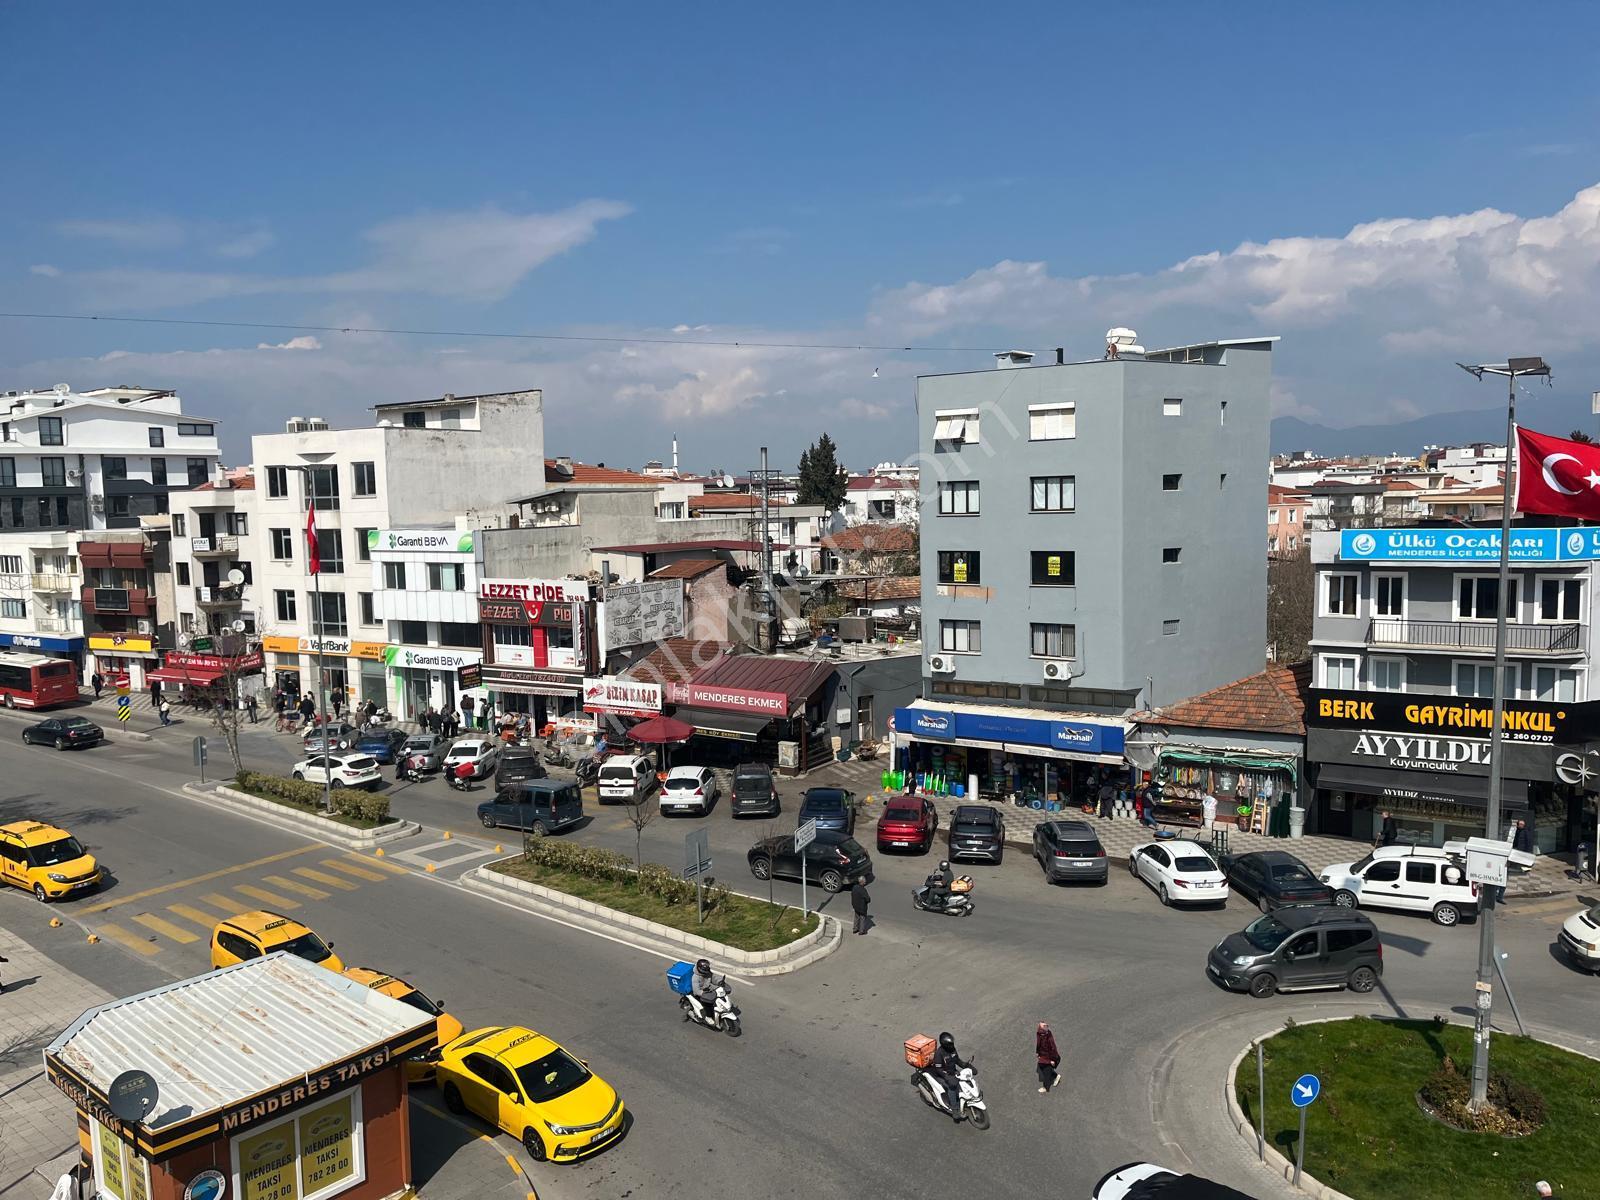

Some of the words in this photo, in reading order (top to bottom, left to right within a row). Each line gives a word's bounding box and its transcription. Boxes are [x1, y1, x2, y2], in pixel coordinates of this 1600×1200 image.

[397, 536, 423, 547] Garanti
[424, 536, 448, 546] BBVA
[1389, 532, 1436, 548] Ülkü
[1449, 549, 1473, 558] İLÇE
[1475, 549, 1543, 558] BAŞANLIĞI
[481, 584, 530, 600] LEZZET
[533, 582, 564, 601] PİDE
[480, 605, 521, 619] LEZZET
[553, 605, 572, 621] PİD
[310, 640, 349, 652] VakıfBank
[413, 655, 440, 664] Garanti
[440, 656, 464, 666] BBVA
[606, 684, 629, 701] BİZİM
[629, 687, 658, 703] KASAP
[694, 691, 746, 705] MENDERES
[748, 697, 783, 709] EKMEK
[1319, 699, 1375, 720] BERK
[917, 720, 948, 729] Marshall
[1058, 732, 1092, 742] Marshall
[1352, 734, 1492, 765] AYYILDIZ
[1390, 758, 1459, 771] Kuyumculuk
[1382, 788, 1419, 799] AYYILDIZ
[54, 1072, 94, 1113] MENDERES
[222, 1076, 331, 1131] MENDERES
[336, 1045, 391, 1082] TAKSİ
[304, 1128, 350, 1157] MENDERES
[316, 1145, 339, 1165] TAKSİ
[244, 1153, 292, 1183] MENDERES
[308, 1169, 324, 1184] 782
[326, 1163, 336, 1176] 28
[338, 1158, 349, 1170] 00
[257, 1171, 281, 1192] TAKSİ
[281, 1183, 292, 1196] 00
